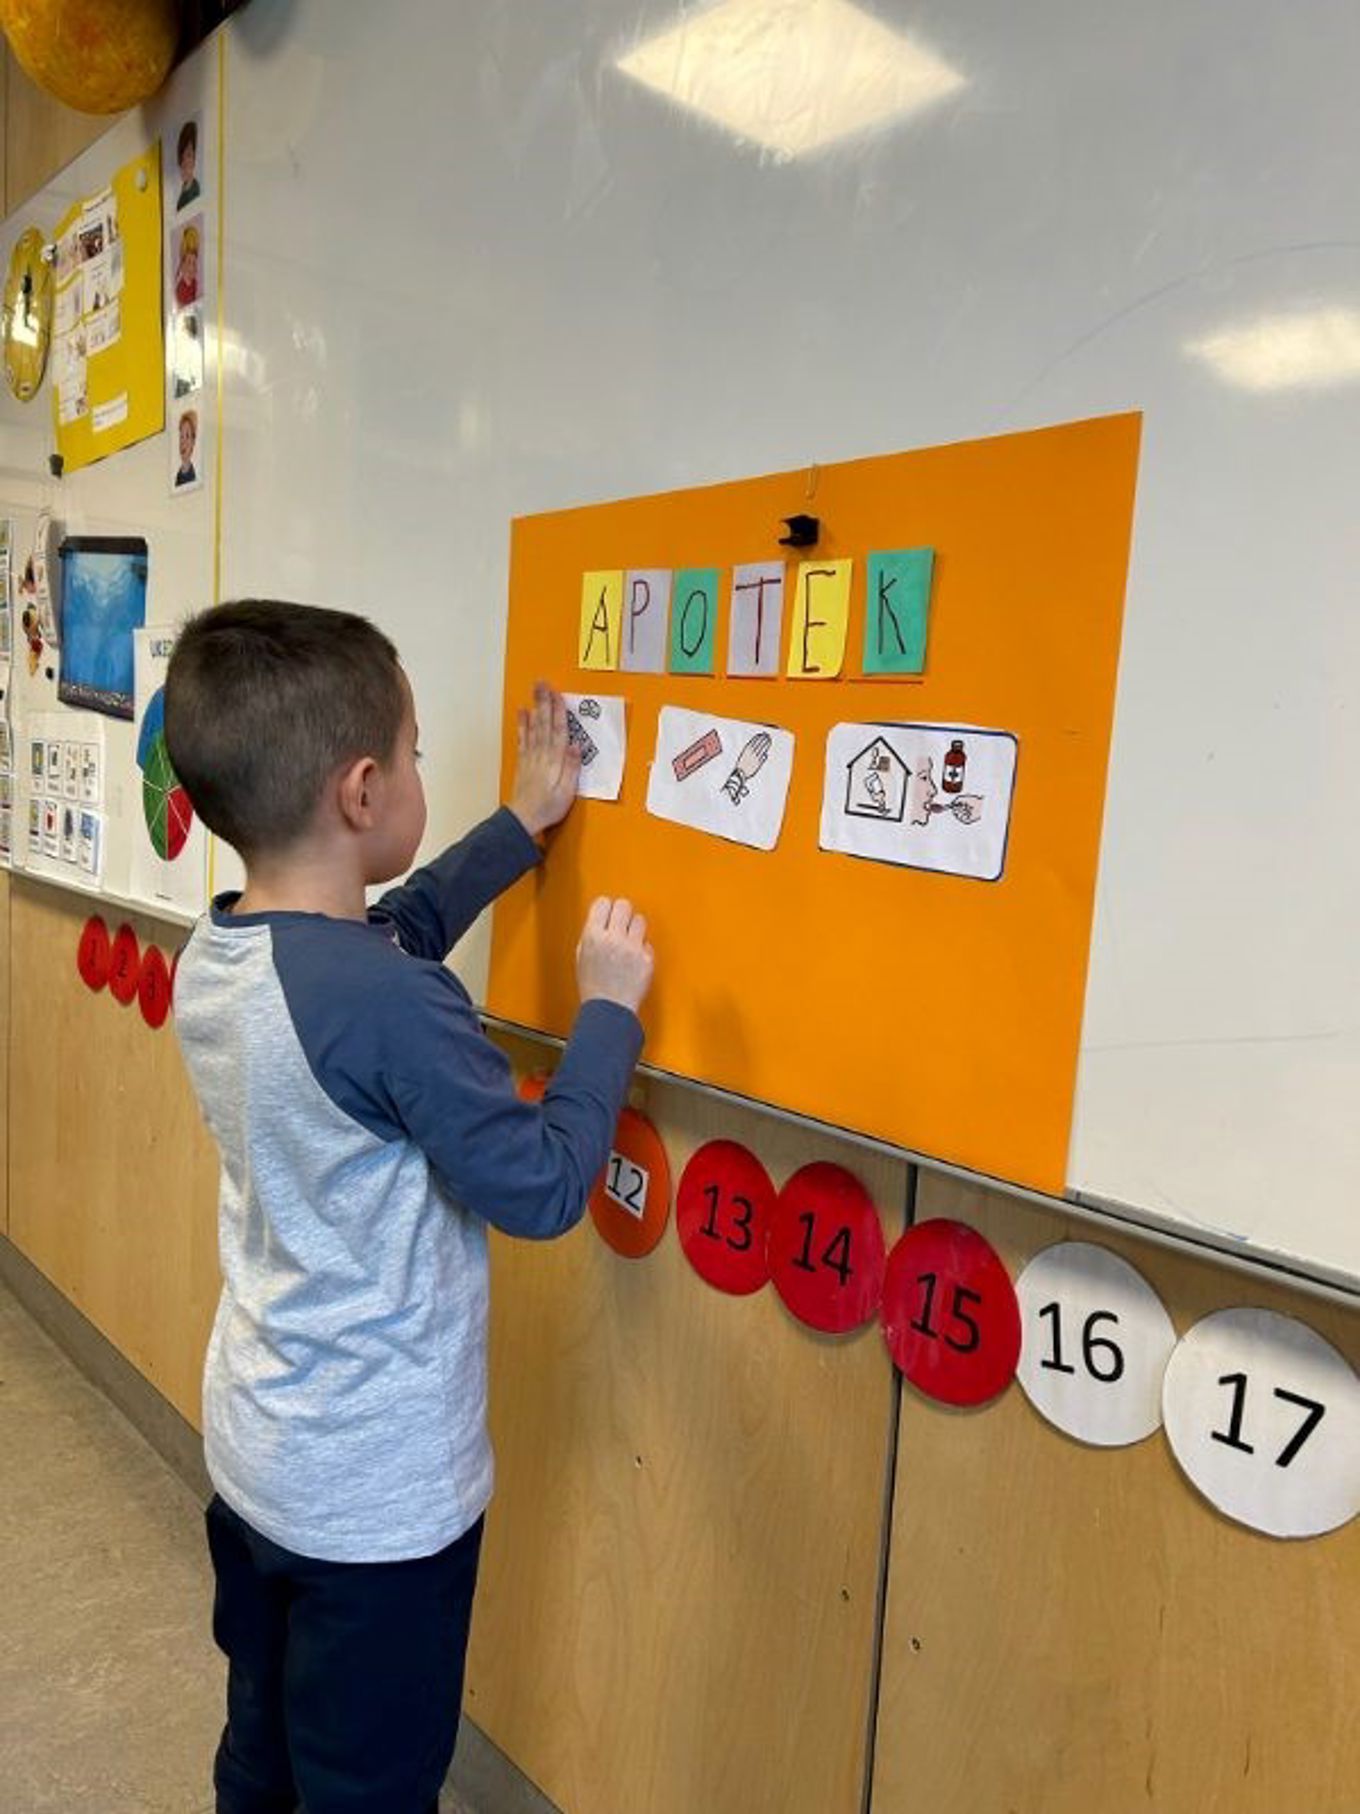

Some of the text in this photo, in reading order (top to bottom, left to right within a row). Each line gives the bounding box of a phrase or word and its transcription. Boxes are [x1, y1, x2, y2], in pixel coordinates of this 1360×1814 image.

[584, 569, 907, 673] APOTEK
[607, 1157, 644, 1212] 12
[701, 1184, 753, 1251] 13
[791, 1211, 855, 1287] 14
[910, 1272, 983, 1355] 15
[1038, 1301, 1125, 1383] 16
[1210, 1371, 1327, 1469] 17
